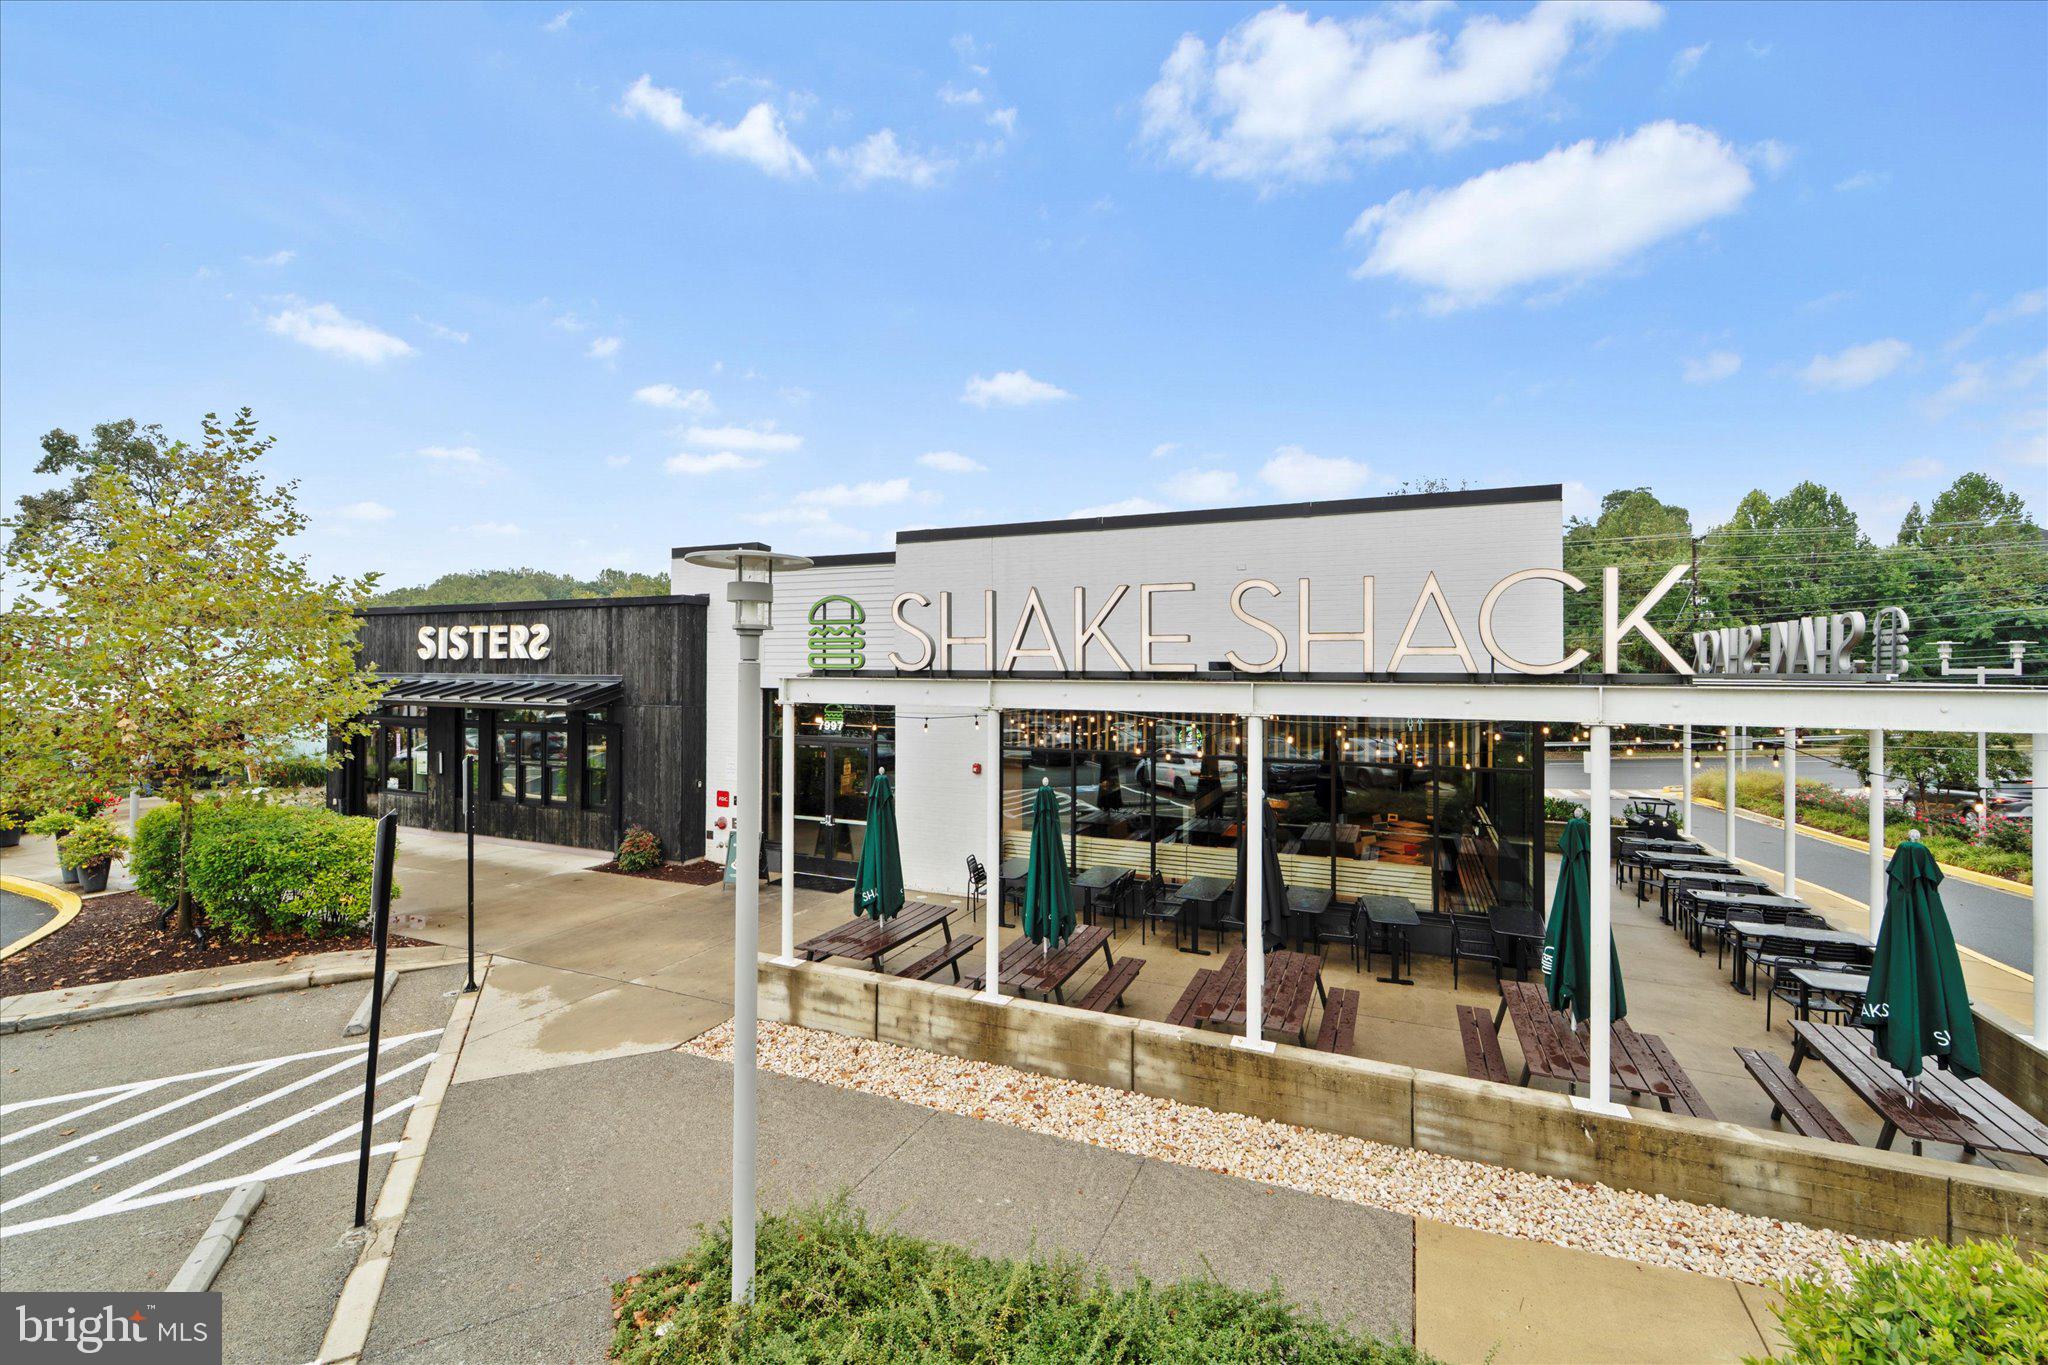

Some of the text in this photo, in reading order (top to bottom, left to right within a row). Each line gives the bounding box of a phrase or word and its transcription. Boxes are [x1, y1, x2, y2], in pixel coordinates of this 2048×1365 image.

[889, 564, 1696, 676] SHAKE SHACK
[417, 623, 551, 660] SISTERS
[818, 721, 844, 731] 7997
